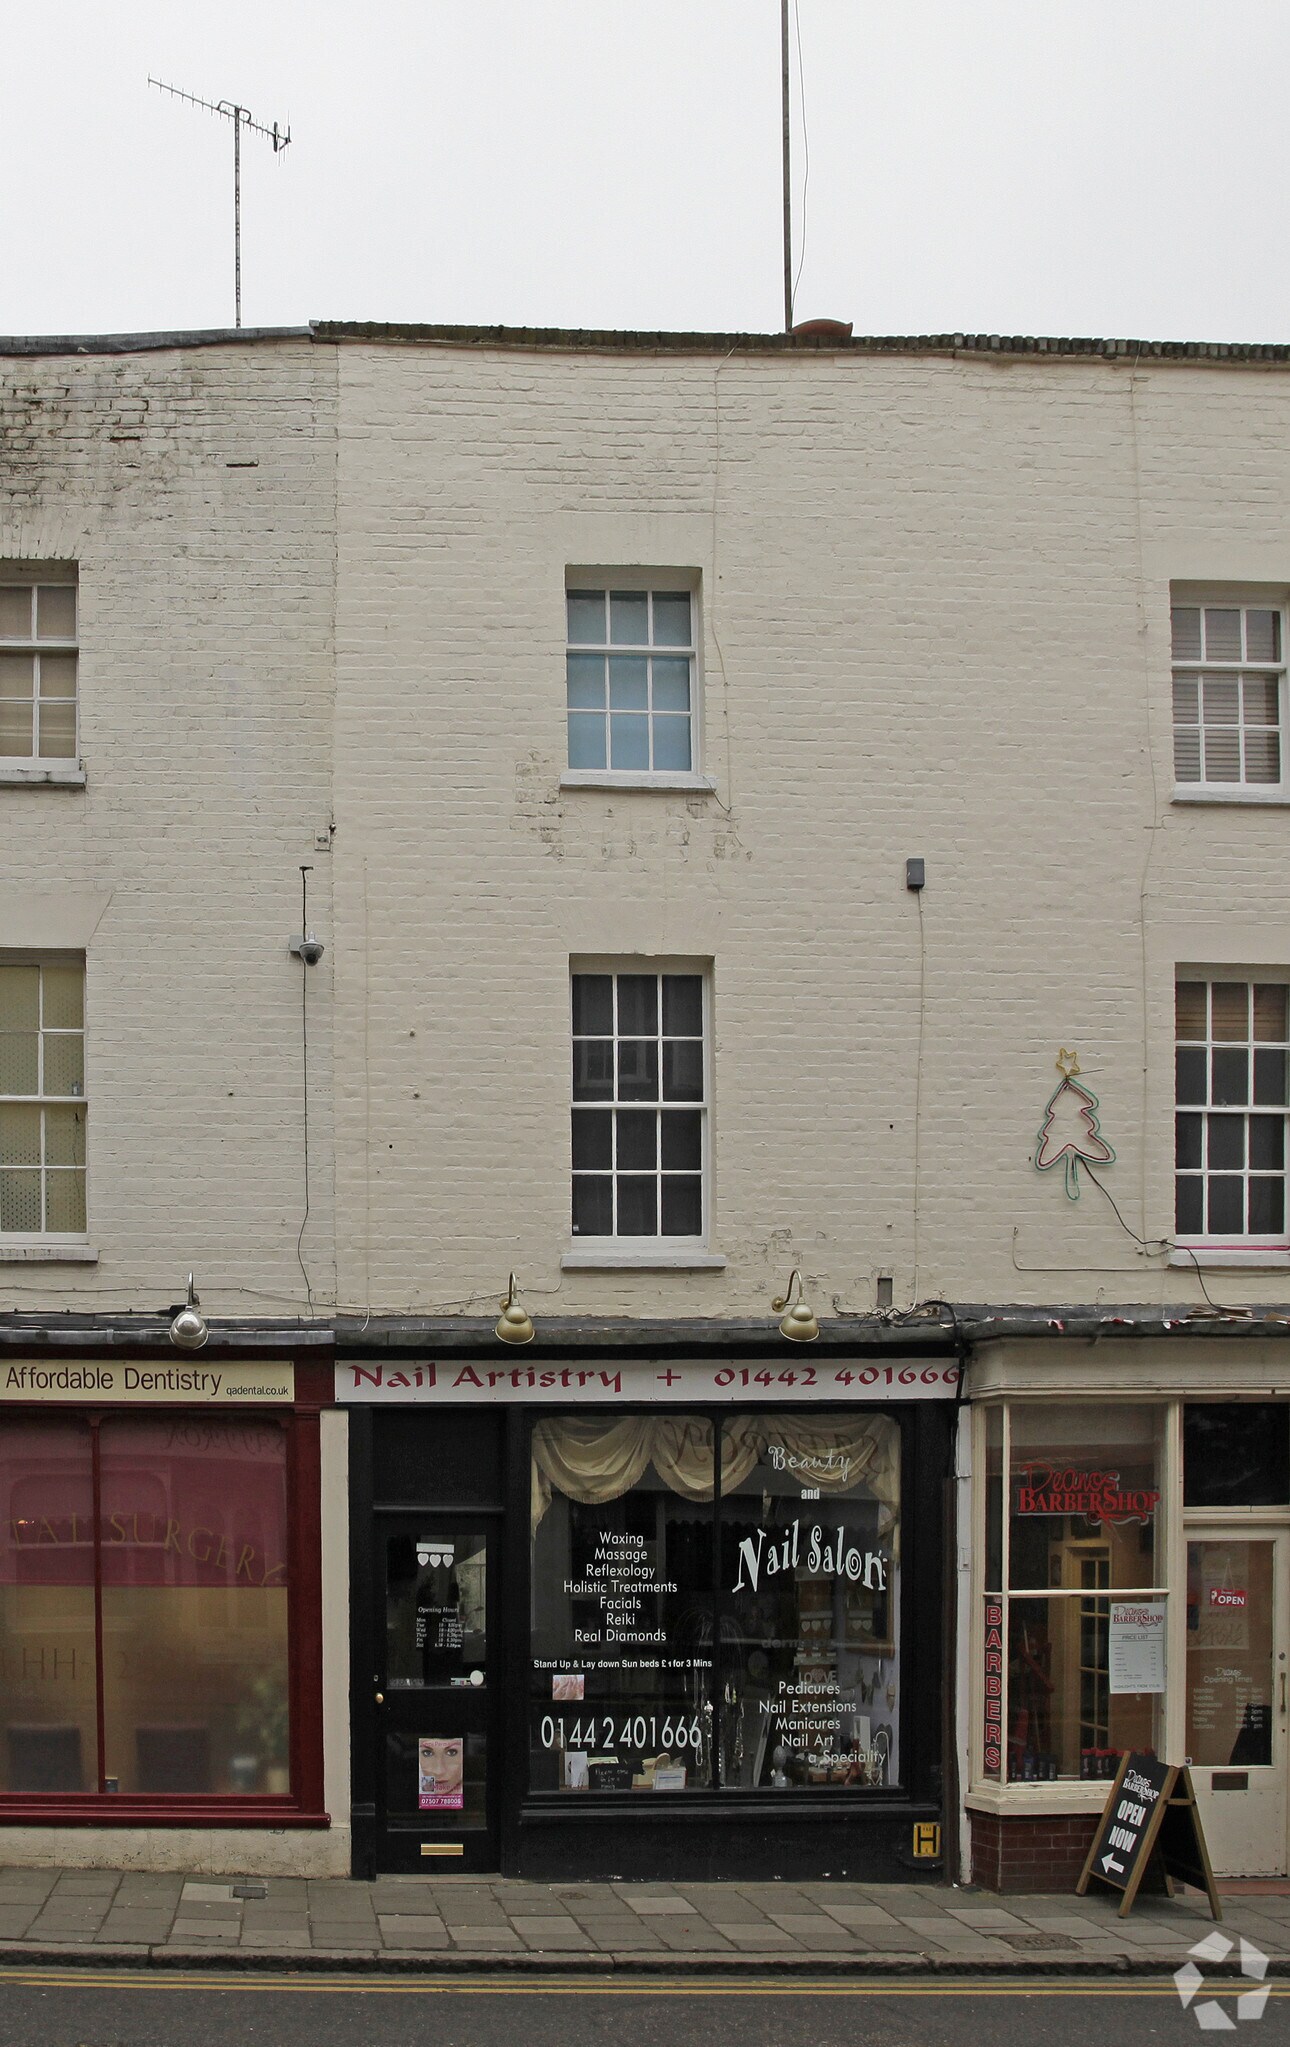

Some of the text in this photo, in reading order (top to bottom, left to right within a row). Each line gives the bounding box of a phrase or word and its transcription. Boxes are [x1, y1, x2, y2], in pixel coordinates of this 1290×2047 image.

[6, 1366, 222, 1395] Affordable Dentistry
[348, 1362, 438, 1389] Nail
[452, 1363, 623, 1394] Artistry
[713, 1365, 819, 1386] 01442
[834, 1366, 960, 1386] 401666
[226, 1385, 289, 1397] qadental.co.uk
[768, 1446, 850, 1482] Beauty
[801, 1487, 820, 1500] and
[600, 1532, 644, 1547] Waxing
[594, 1548, 648, 1563] Massage
[732, 1519, 888, 1593] Nail Salon
[586, 1563, 655, 1579] Reflexology
[563, 1580, 678, 1593] Holistic Treatments
[600, 1596, 642, 1609] Facials
[1218, 1595, 1245, 1605] OPEN
[606, 1613, 635, 1625] Reiki
[574, 1628, 667, 1642] Real Diamonds
[534, 1660, 557, 1668] Stand
[560, 1660, 571, 1670] Up
[573, 1660, 579, 1668] &
[581, 1660, 596, 1669] Lay
[598, 1660, 620, 1668] down
[622, 1660, 638, 1668] Sun
[640, 1660, 659, 1668] beds
[693, 1659, 712, 1668] Mins
[778, 1681, 841, 1695] Pedicures
[985, 1605, 1002, 1768] BARBERS
[759, 1700, 857, 1714] Nail Extensions
[776, 1717, 841, 1730] Manicures
[781, 1733, 834, 1747] Nail Art
[808, 1750, 886, 1766] a Speciality
[1117, 1799, 1147, 1827] OPEN
[917, 1825, 937, 1853] H
[1108, 1825, 1138, 1853] NOW
